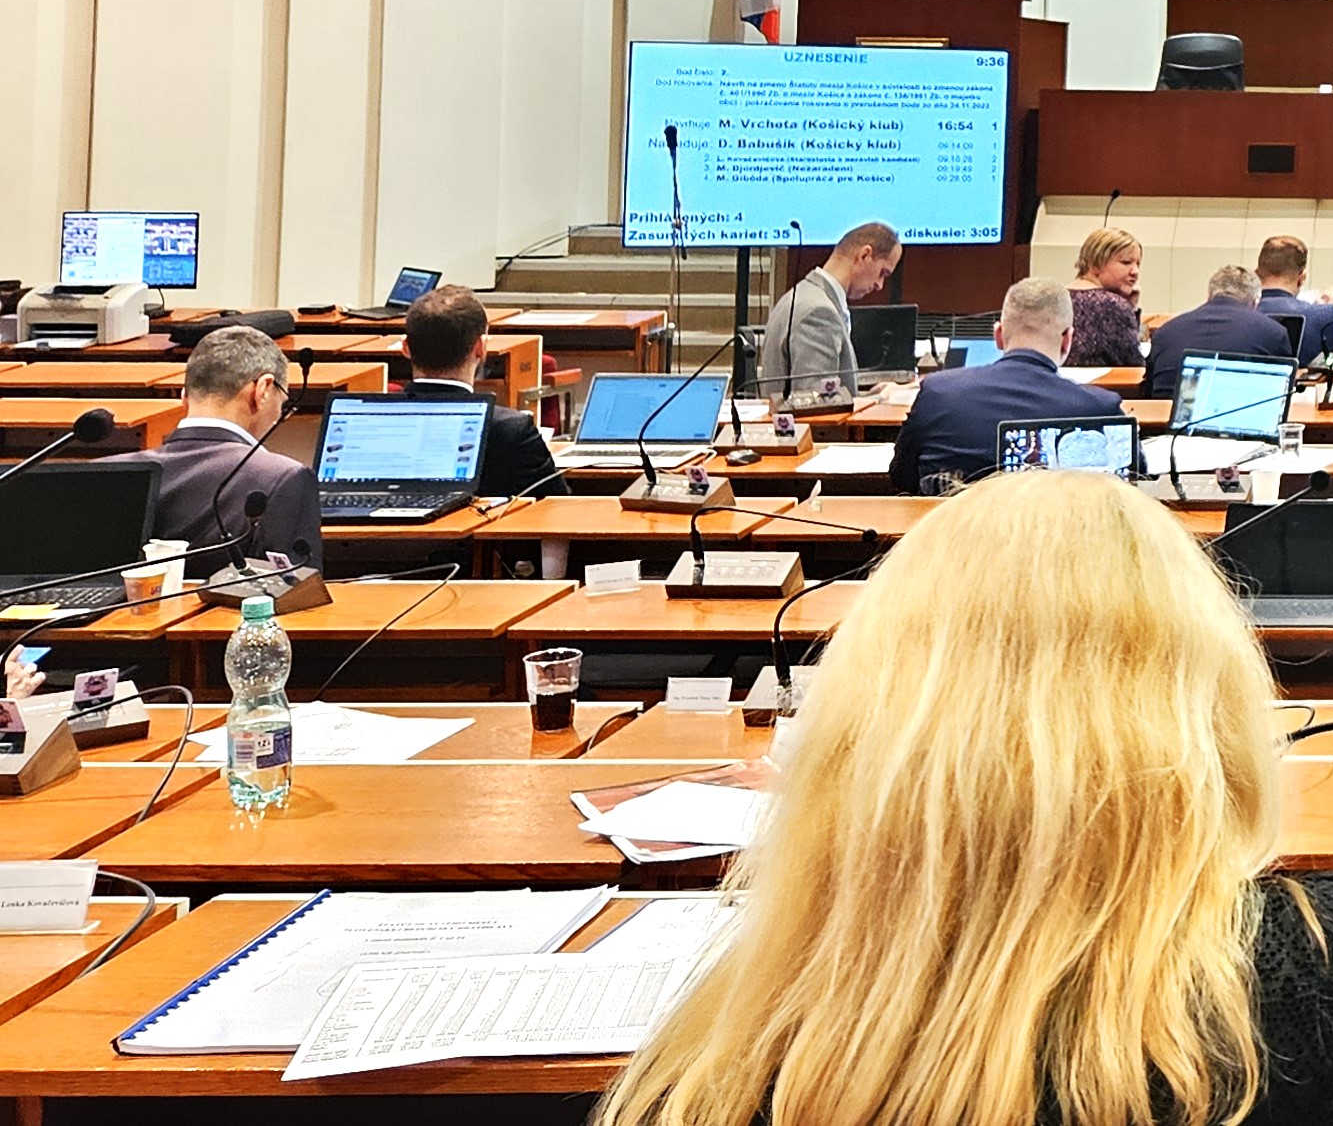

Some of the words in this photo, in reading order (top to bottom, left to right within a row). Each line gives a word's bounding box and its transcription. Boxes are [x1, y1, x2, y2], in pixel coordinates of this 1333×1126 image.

[784, 51, 869, 64] UZNESENIE
[976, 56, 1005, 67] 9:36
[719, 119, 736, 129] M.
[740, 118, 798, 130] Vrchota
[803, 118, 865, 133] (Košický
[869, 119, 904, 132] klub)
[938, 121, 974, 131] 16:54
[718, 138, 733, 149] D.
[800, 138, 862, 153] (Košický
[867, 138, 901, 152] klub)
[629, 211, 730, 225] Prihláených:
[734, 212, 743, 222] 4
[772, 229, 790, 240] 35
[904, 227, 967, 239] diskusie:
[970, 227, 999, 238] 3:05
